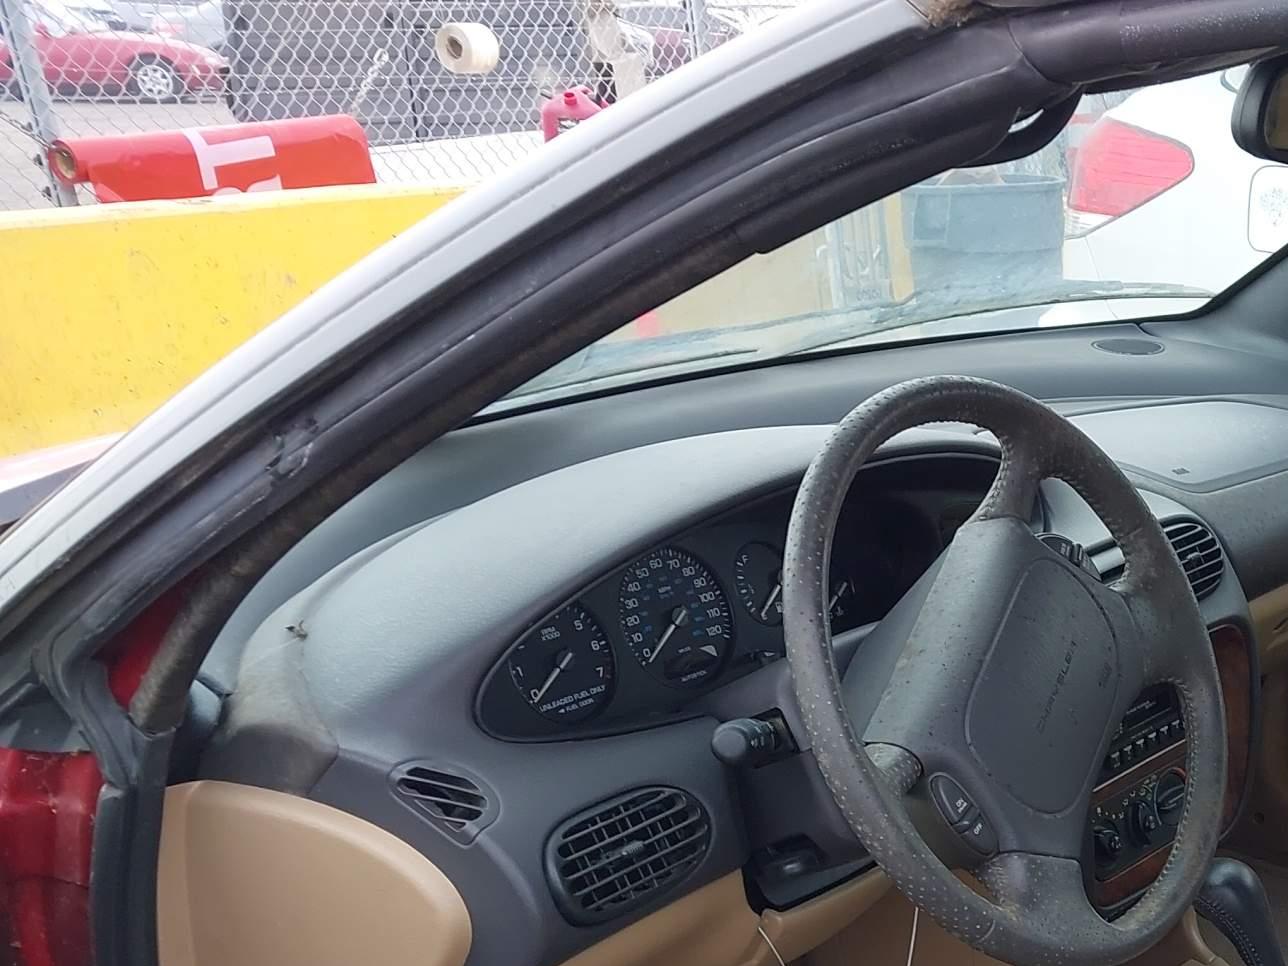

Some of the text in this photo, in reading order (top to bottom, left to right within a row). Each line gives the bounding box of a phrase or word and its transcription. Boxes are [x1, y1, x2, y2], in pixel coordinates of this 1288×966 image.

[649, 558, 663, 569] 60
[666, 559, 680, 570] 70
[635, 567, 649, 578] 50
[682, 566, 695, 576] 80
[627, 581, 641, 592] 40
[693, 577, 706, 588] 90
[699, 591, 715, 602] 100
[624, 598, 639, 609] 30
[706, 607, 720, 618] 110
[574, 620, 583, 631] 5
[625, 615, 640, 626] 20
[706, 625, 722, 636] 120
[631, 632, 643, 643] 10
[591, 640, 600, 651] 6
[642, 648, 651, 657] 0
[595, 666, 604, 678] 7
[530, 688, 540, 700] 0
[539, 695, 574, 712] UNLEADED
[574, 690, 591, 701] FUEL
